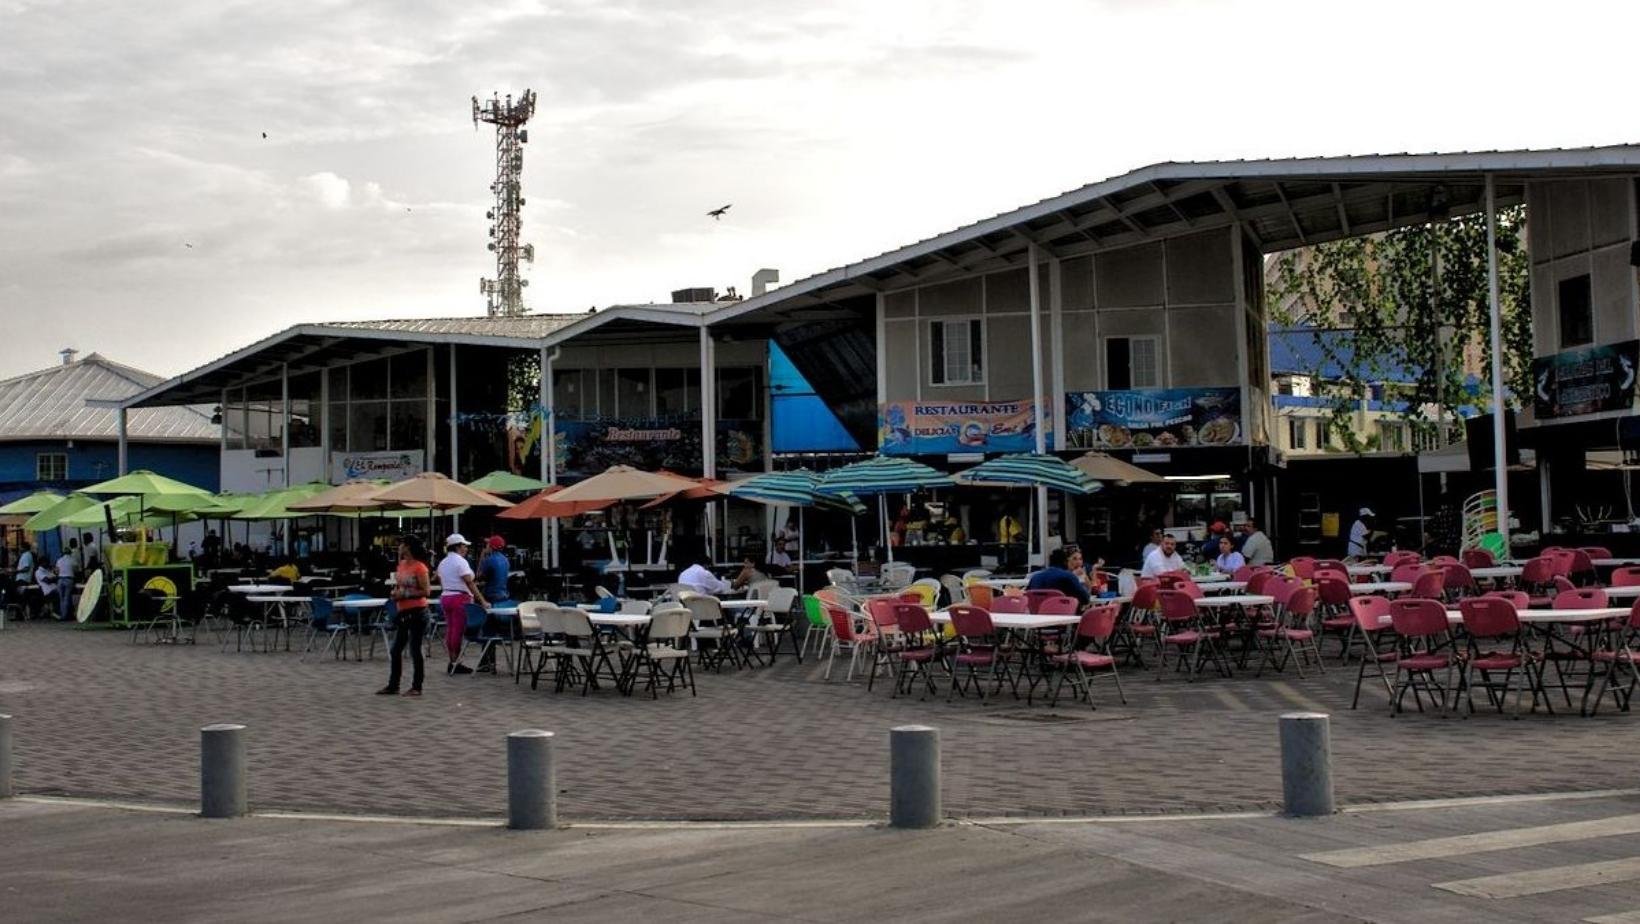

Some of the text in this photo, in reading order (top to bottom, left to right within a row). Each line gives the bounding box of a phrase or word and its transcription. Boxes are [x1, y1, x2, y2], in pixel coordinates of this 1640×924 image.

[914, 402, 1019, 416] RESTAURANTE
[604, 426, 681, 442] Restaurante
[914, 424, 959, 436] DELICIAS
